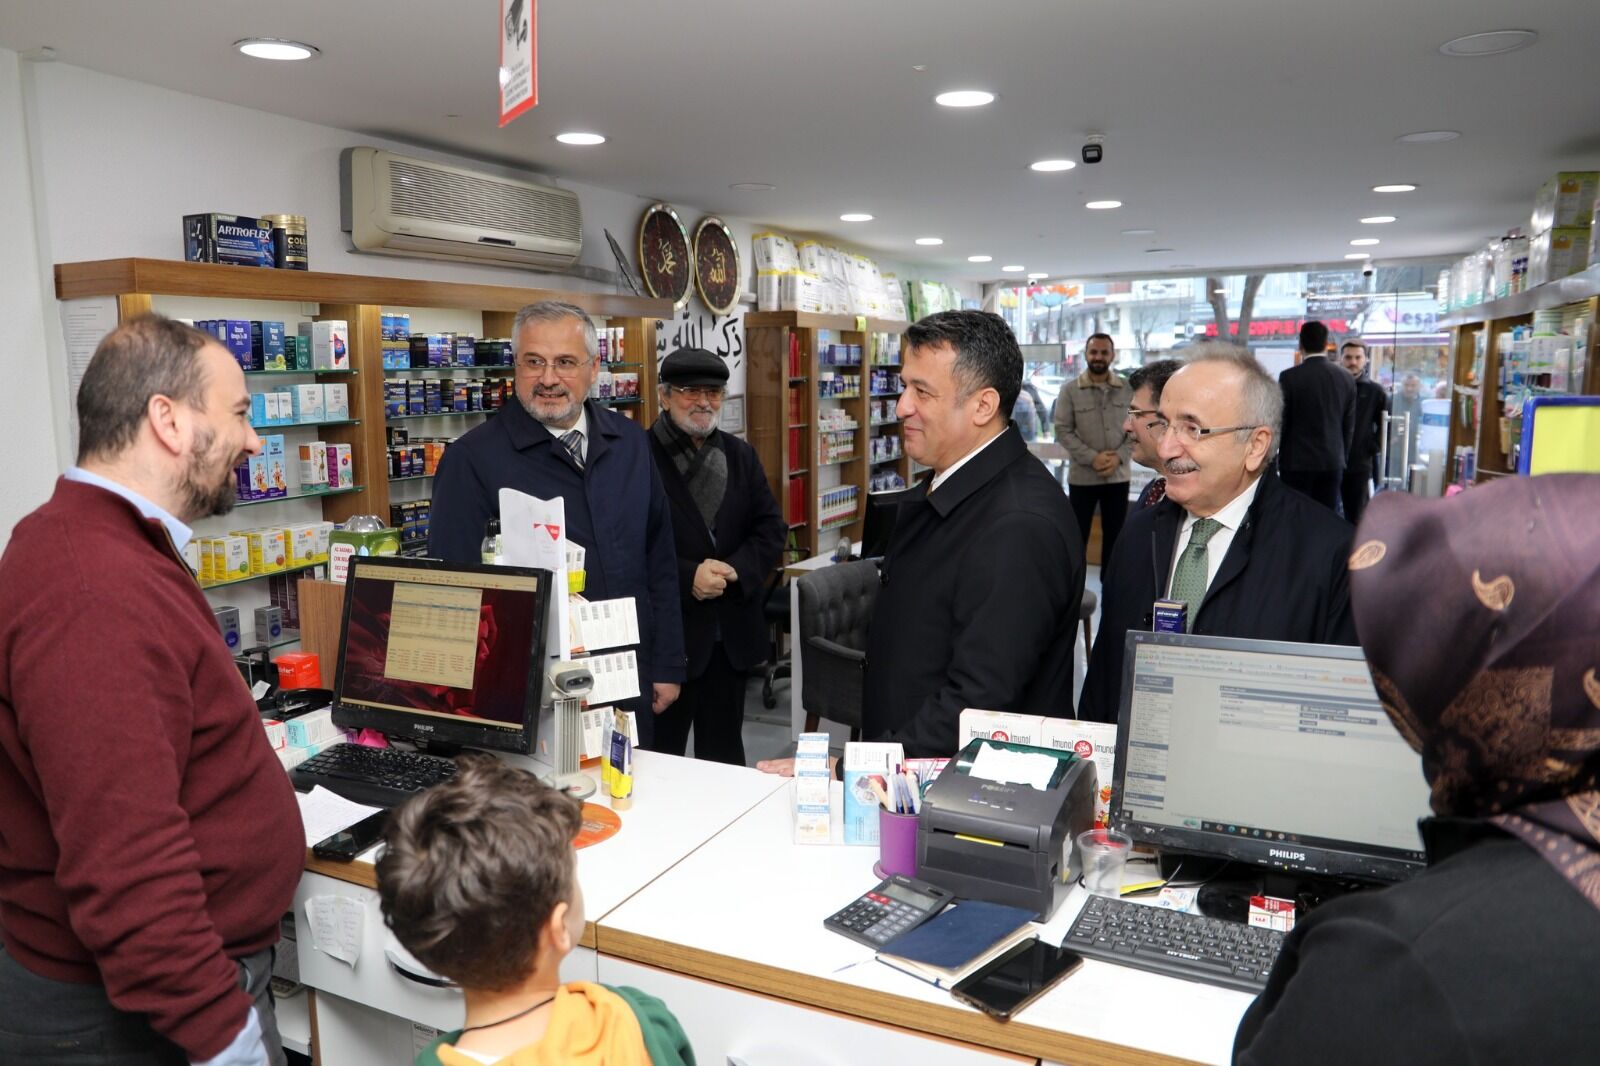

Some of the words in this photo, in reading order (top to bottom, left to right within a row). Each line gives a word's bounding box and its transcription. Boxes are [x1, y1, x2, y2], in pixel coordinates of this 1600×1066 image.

[218, 225, 270, 240] ARTROFLEX
[413, 723, 434, 732] PHILIPS
[1269, 848, 1306, 861] PHILIPS
